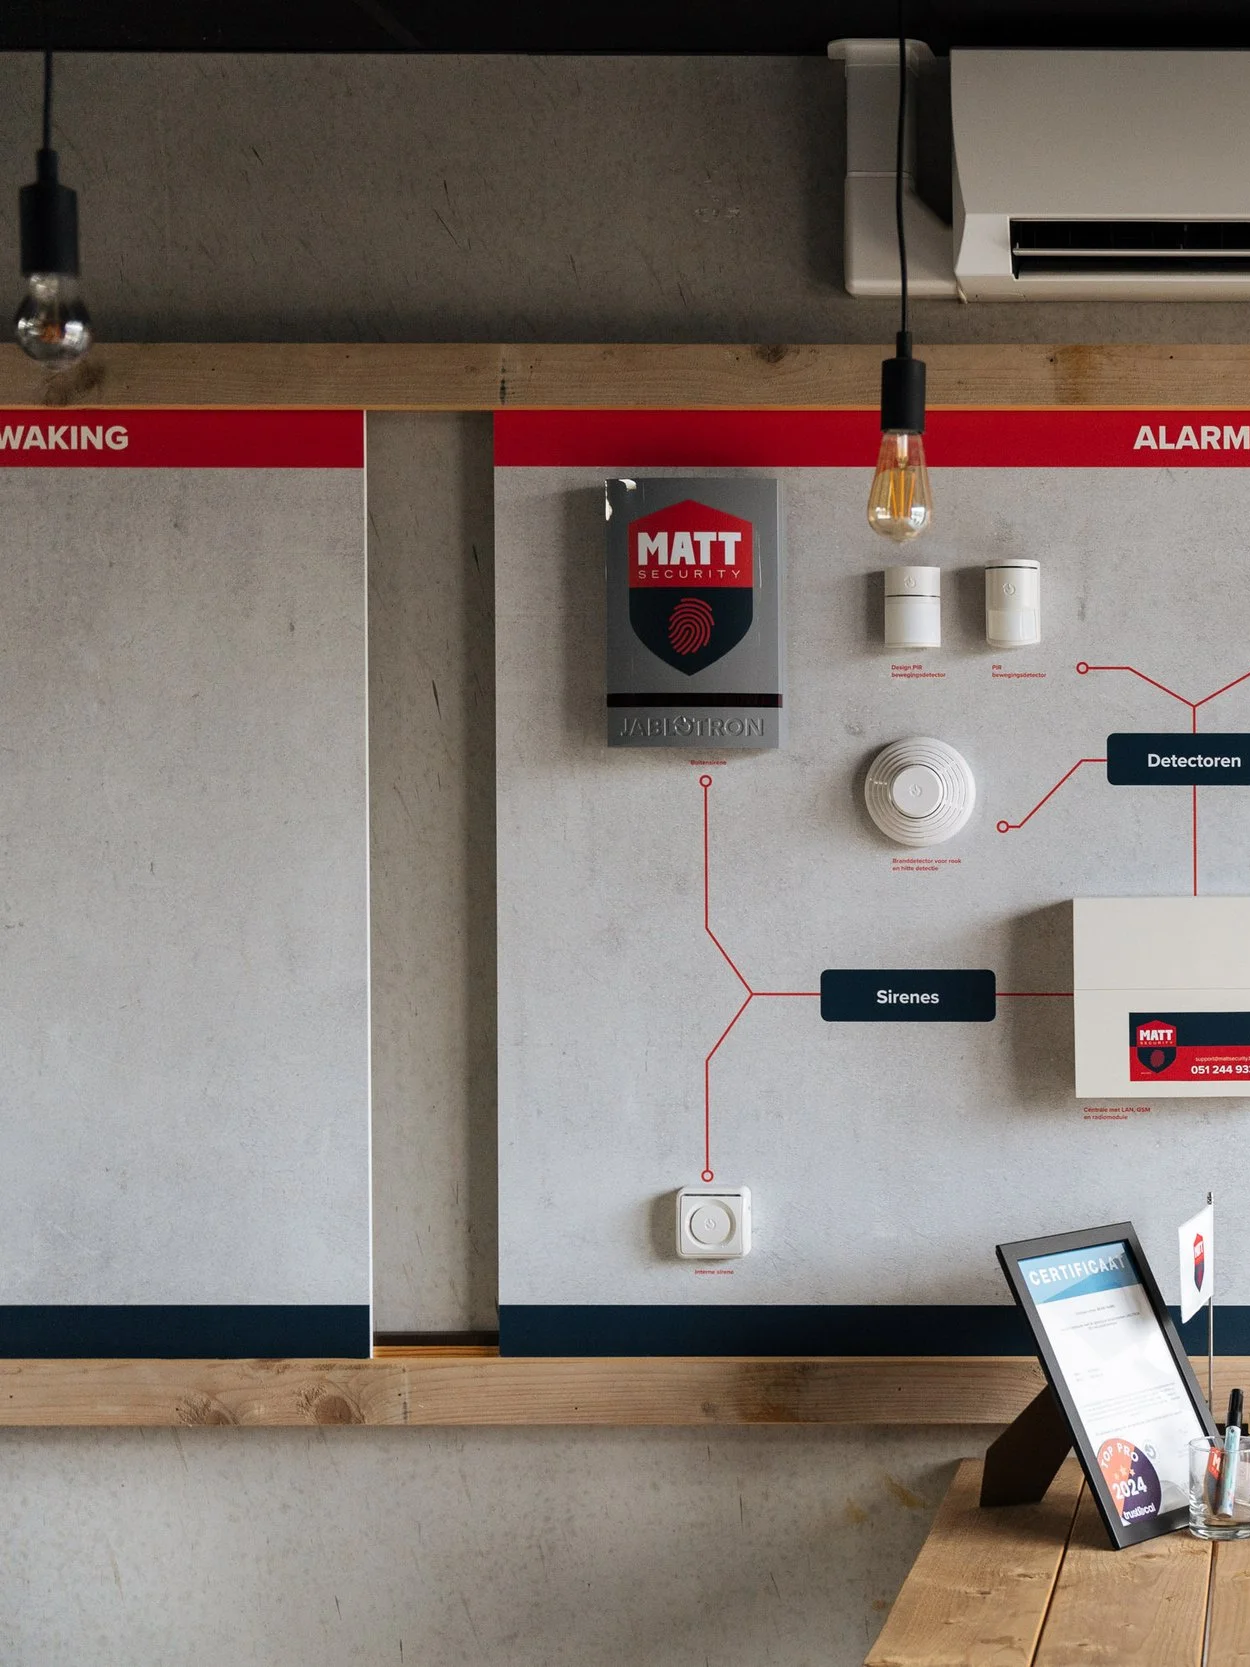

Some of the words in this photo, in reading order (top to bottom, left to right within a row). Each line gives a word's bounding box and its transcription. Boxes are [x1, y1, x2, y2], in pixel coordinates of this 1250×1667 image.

[1133, 425, 1250, 450] ALARM
[637, 531, 742, 566] MATT
[638, 569, 741, 579] SECURITY
[891, 664, 912, 672] Design
[1147, 753, 1241, 768] Detectoren
[876, 989, 939, 1004] Sirenes
[1139, 1029, 1173, 1041] MATT
[1191, 1065, 1210, 1075] 051
[1212, 1065, 1233, 1075] 244
[1029, 1254, 1126, 1286] CERTIFICAAT
[1100, 1445, 1114, 1469] TOP
[1116, 1442, 1139, 1463] PRO
[1112, 1476, 1147, 1500] 2024
